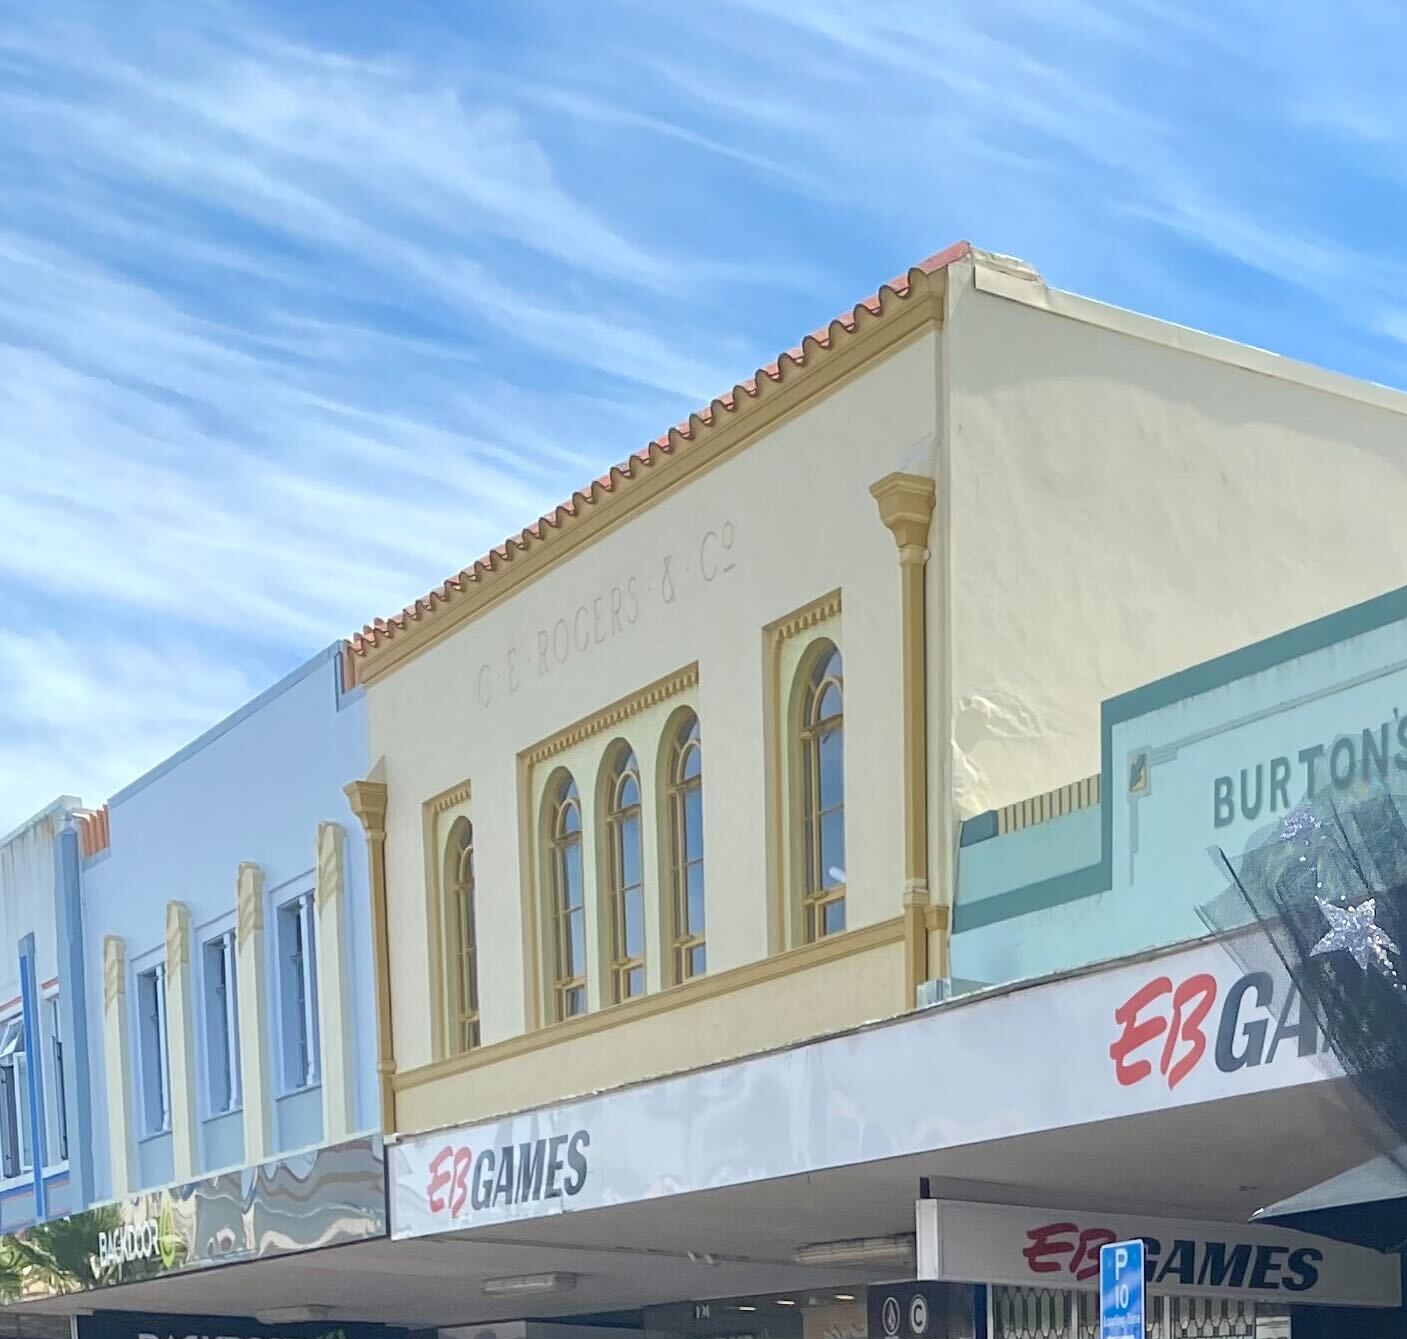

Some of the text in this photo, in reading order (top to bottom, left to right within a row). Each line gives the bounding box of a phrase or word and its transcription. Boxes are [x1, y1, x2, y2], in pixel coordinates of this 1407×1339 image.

[538, 576, 639, 677] ROGERS
[1109, 973, 1217, 1091] EB
[427, 1129, 590, 1218] EB GAMES
[98, 1219, 160, 1268] BACKDOOR
[1115, 1248, 1128, 1281] P
[1115, 1284, 1129, 1309] 10
